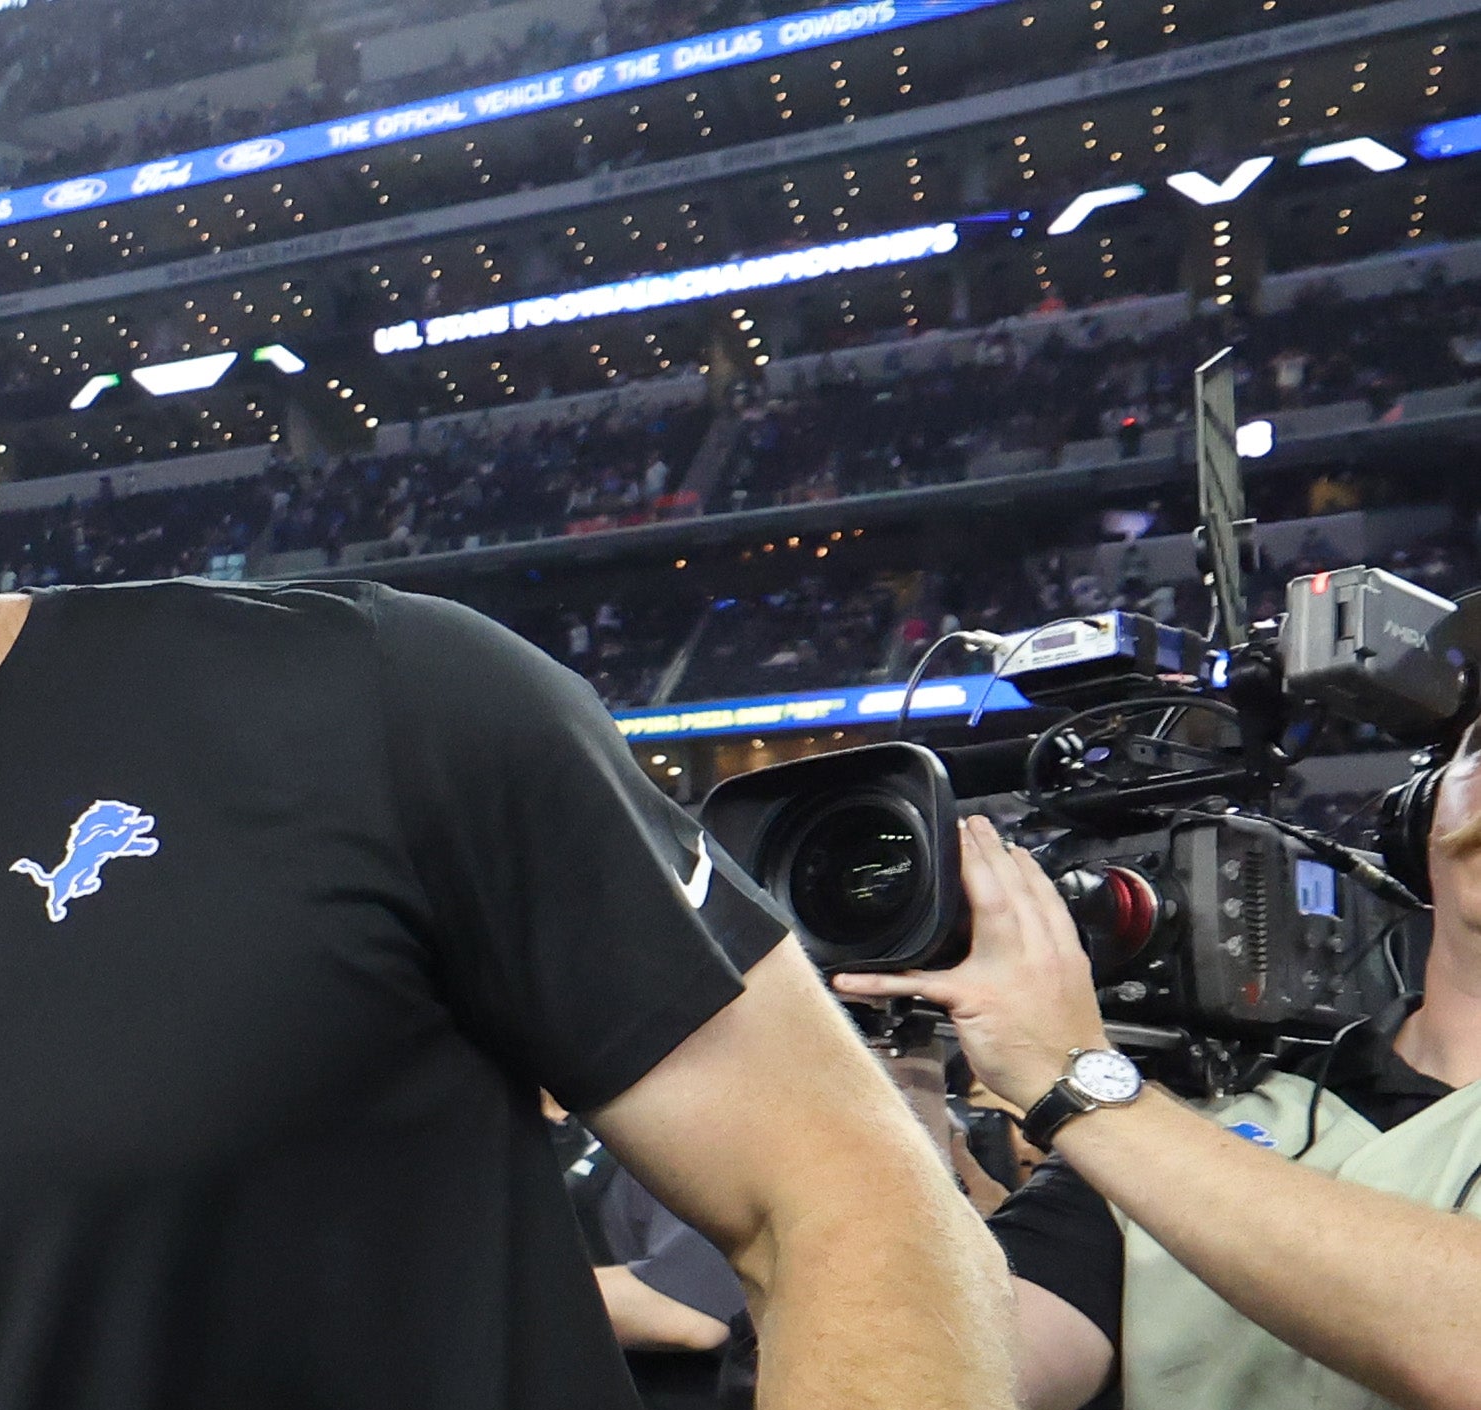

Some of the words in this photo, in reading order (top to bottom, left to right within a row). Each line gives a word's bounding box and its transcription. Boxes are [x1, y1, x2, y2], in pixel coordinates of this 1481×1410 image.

[328, 119, 371, 147] THE
[374, 101, 467, 139] OFFICIAL
[475, 76, 565, 115] VEHICLE
[573, 66, 606, 93] OF
[615, 53, 660, 82] THE
[672, 30, 763, 70] DALLAS
[777, 2, 896, 46] COWBOYS
